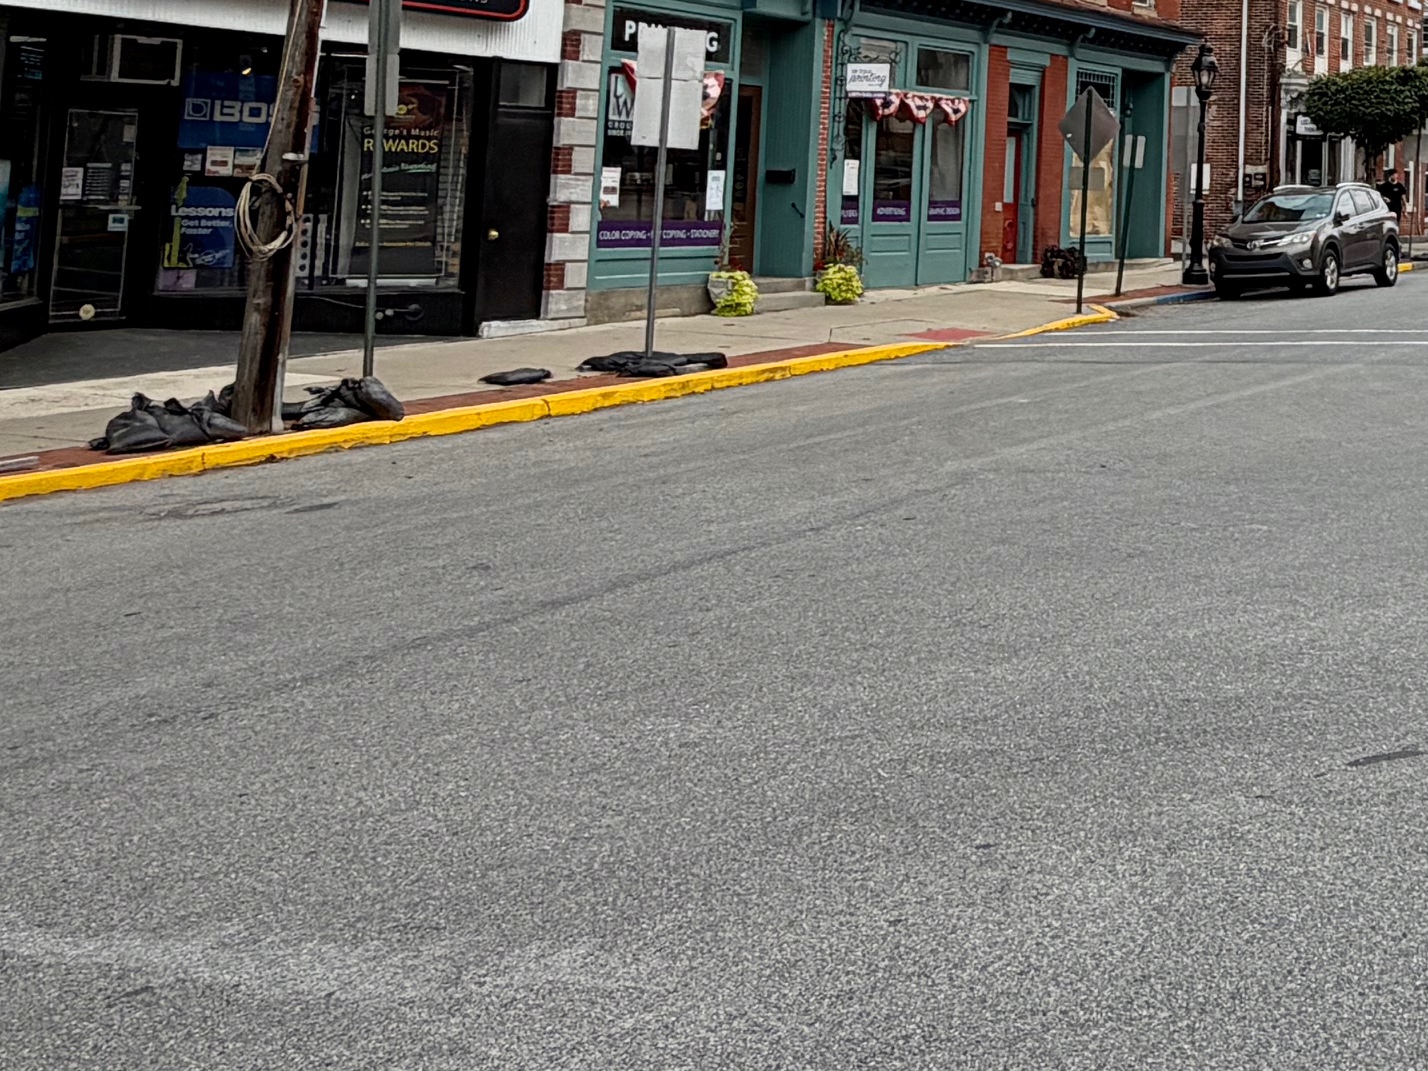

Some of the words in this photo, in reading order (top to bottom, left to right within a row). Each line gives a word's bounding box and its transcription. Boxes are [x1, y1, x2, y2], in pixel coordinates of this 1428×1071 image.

[411, 129, 440, 137] Music
[363, 138, 439, 154] RWARDS
[171, 204, 235, 217] Lessons
[599, 231, 620, 240] COLOR
[621, 230, 647, 240] COPYING
[662, 229, 687, 239] COPYING
